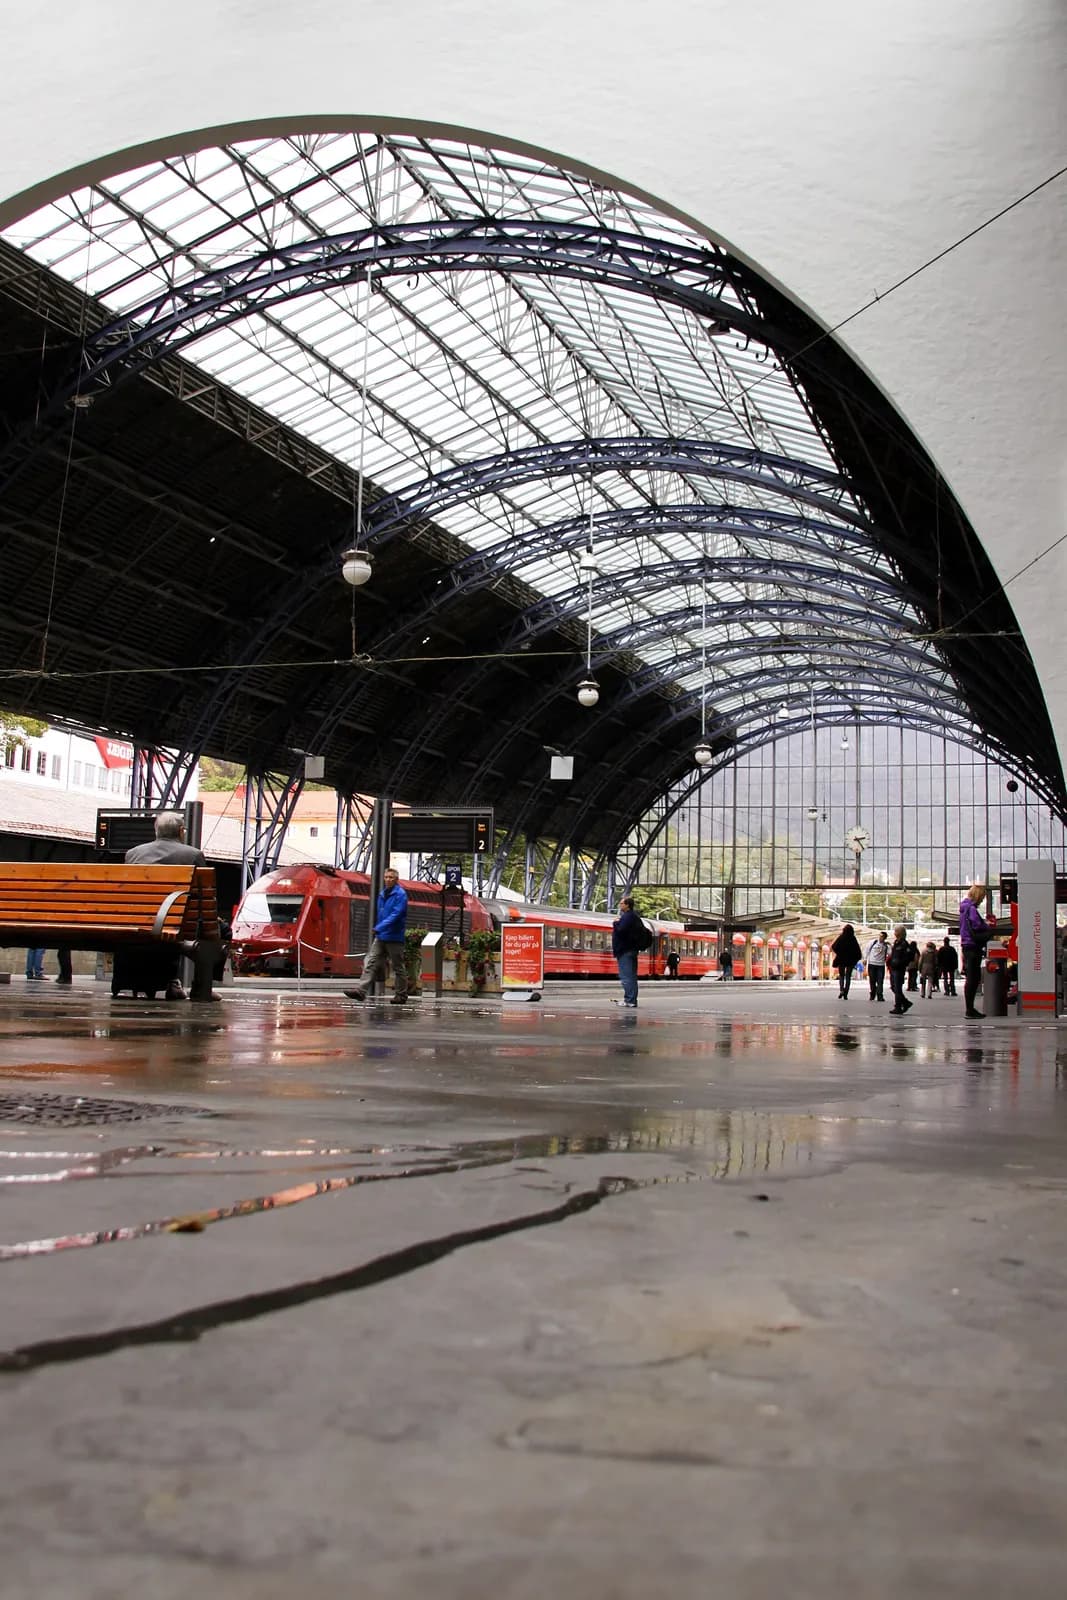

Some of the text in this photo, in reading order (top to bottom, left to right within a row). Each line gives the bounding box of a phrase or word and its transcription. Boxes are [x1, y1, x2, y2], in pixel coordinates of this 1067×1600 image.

[99, 837, 105, 846] 3
[478, 840, 485, 850] 2
[450, 872, 457, 882] 2
[1033, 911, 1041, 971] Billetter/Tickets
